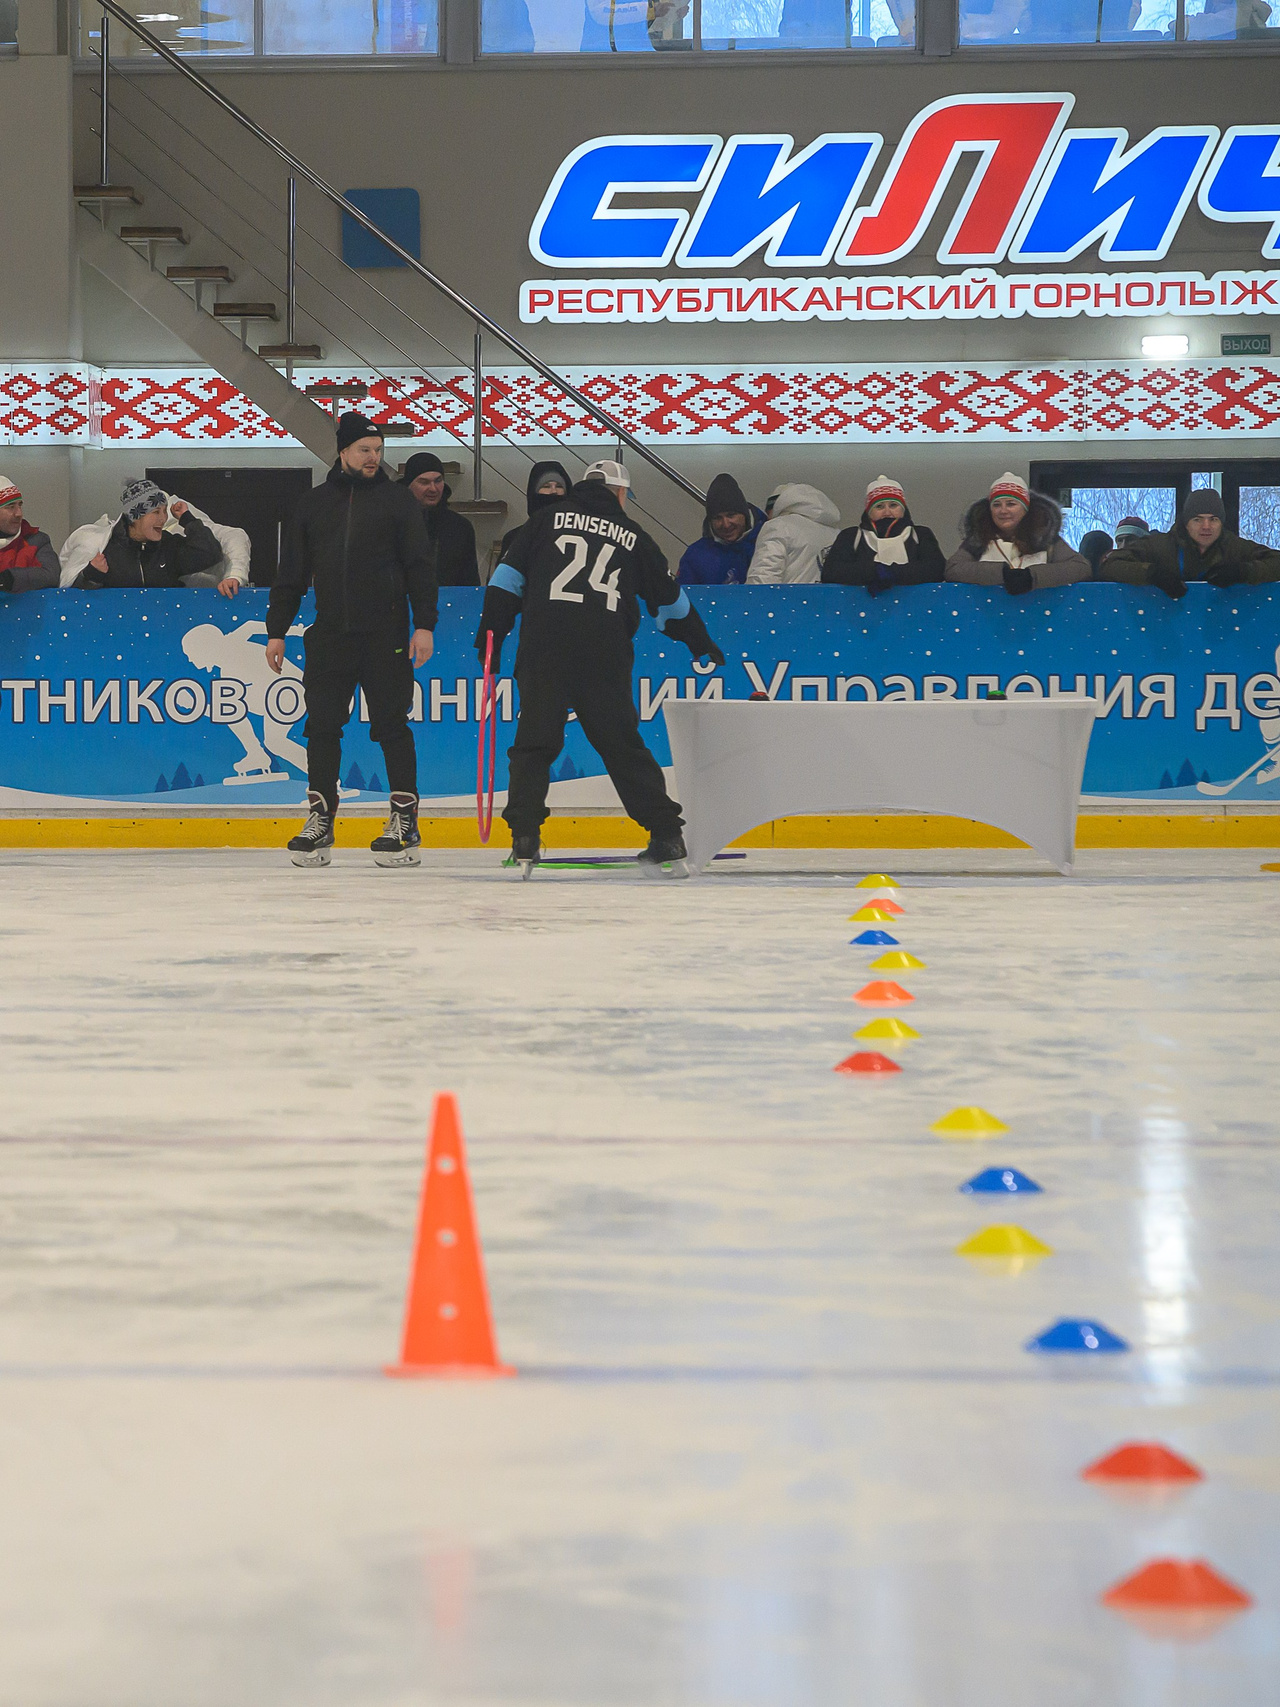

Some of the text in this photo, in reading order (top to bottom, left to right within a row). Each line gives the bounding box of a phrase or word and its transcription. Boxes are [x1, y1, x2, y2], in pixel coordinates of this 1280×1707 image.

[528, 277, 1279, 314] РЕСПУБЛИКАНСКИЙ ГОРНОЛЫЖ
[1223, 338, 1270, 352] ВЫХОД
[554, 512, 637, 551] DENISENKO
[549, 534, 622, 612] 24
